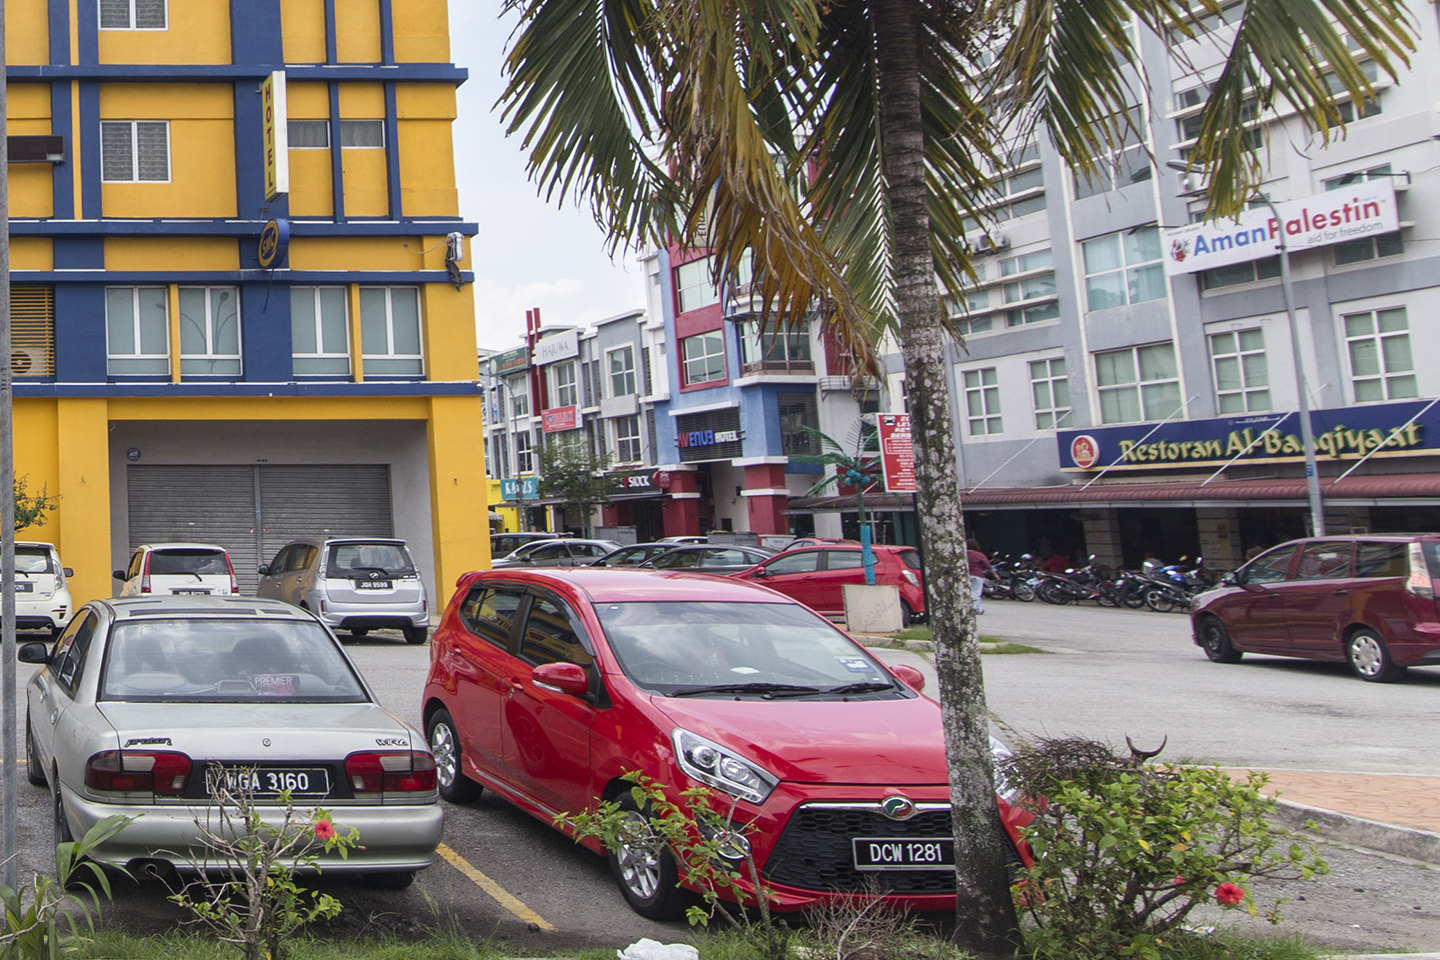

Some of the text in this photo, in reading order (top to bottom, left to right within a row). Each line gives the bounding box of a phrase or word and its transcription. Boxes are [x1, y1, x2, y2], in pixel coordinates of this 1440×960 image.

[264, 83, 274, 189] HOTEL
[1307, 220, 1384, 244] aid for freedom
[1119, 439, 1222, 463] Restoran
[254, 676, 293, 686] PREMIER
[266, 772, 309, 790] 3160
[869, 843, 943, 862] DCW 1281
